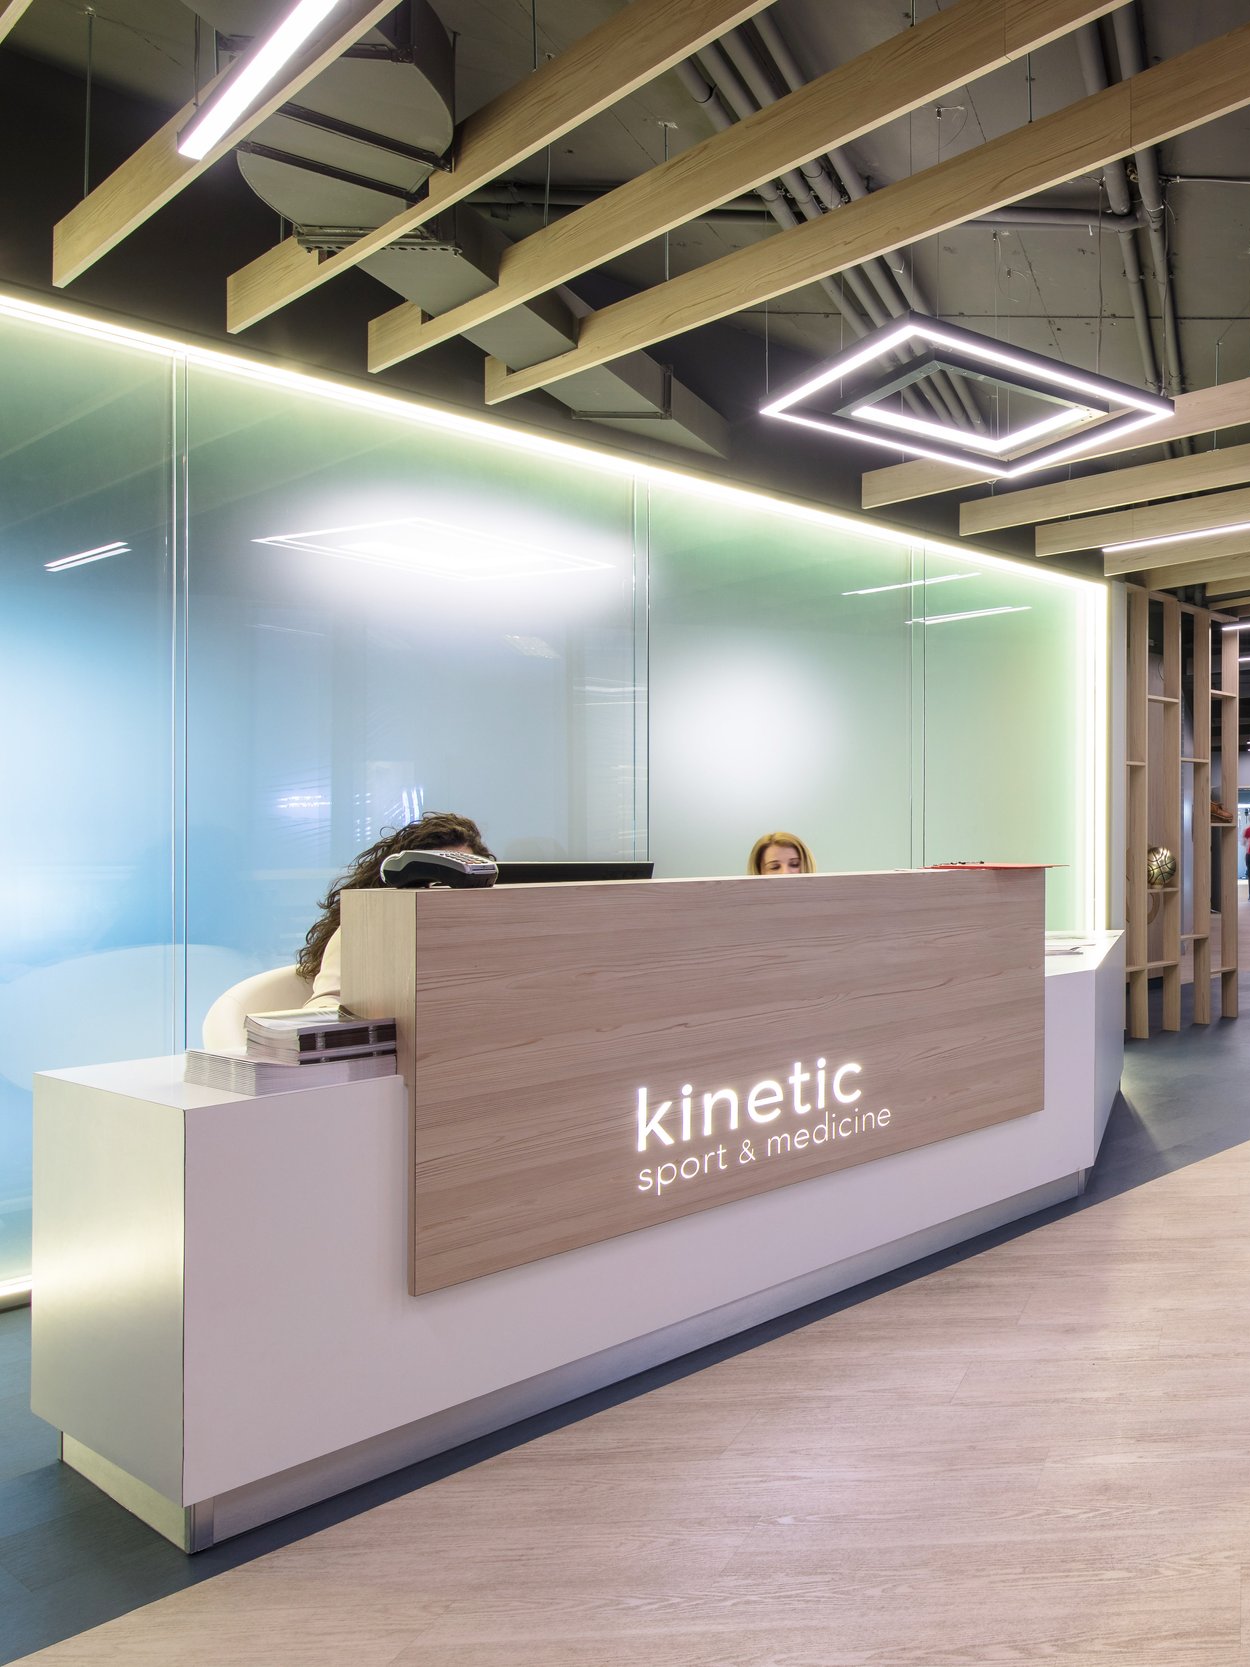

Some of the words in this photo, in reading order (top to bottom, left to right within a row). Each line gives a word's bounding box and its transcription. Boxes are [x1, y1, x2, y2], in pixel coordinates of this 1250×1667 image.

[637, 1057, 862, 1152] kinetic
[637, 1144, 728, 1196] sport
[738, 1139, 756, 1165] &
[767, 1108, 892, 1156] medicine
